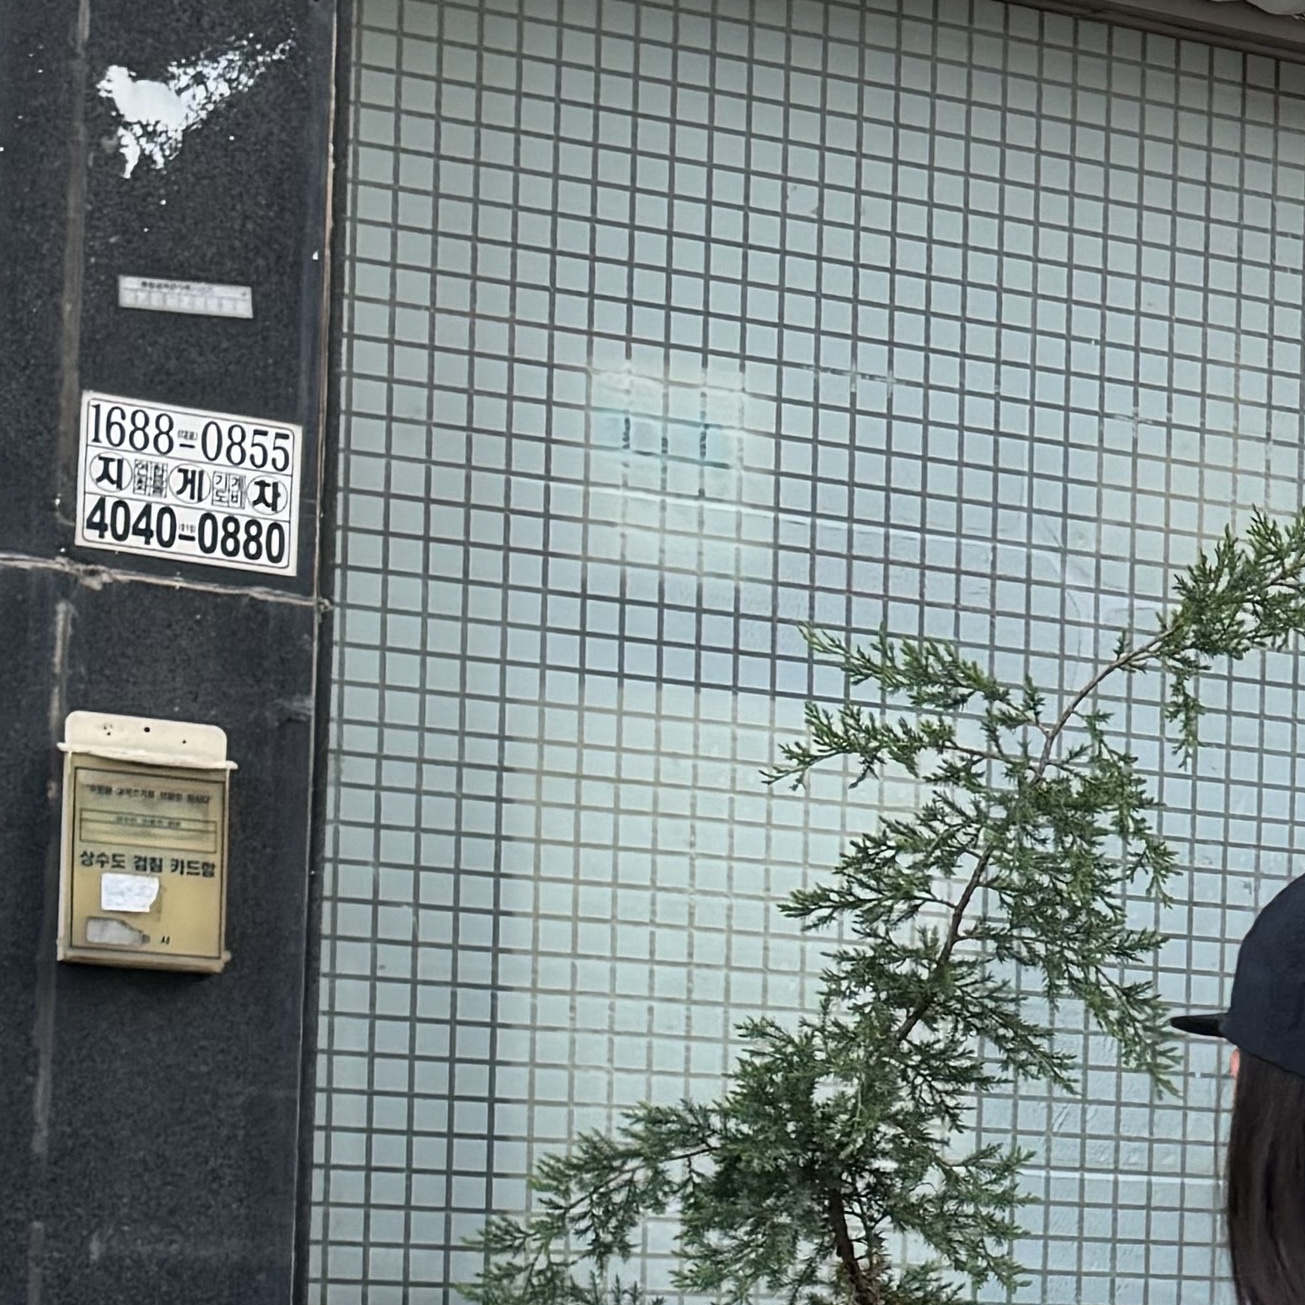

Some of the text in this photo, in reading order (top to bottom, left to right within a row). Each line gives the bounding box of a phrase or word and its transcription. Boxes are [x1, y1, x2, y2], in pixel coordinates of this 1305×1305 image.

[91, 403, 290, 472] 1688-0855
[86, 496, 285, 563] 4040-0880
[80, 850, 217, 878] 상수도 검침 카드함
